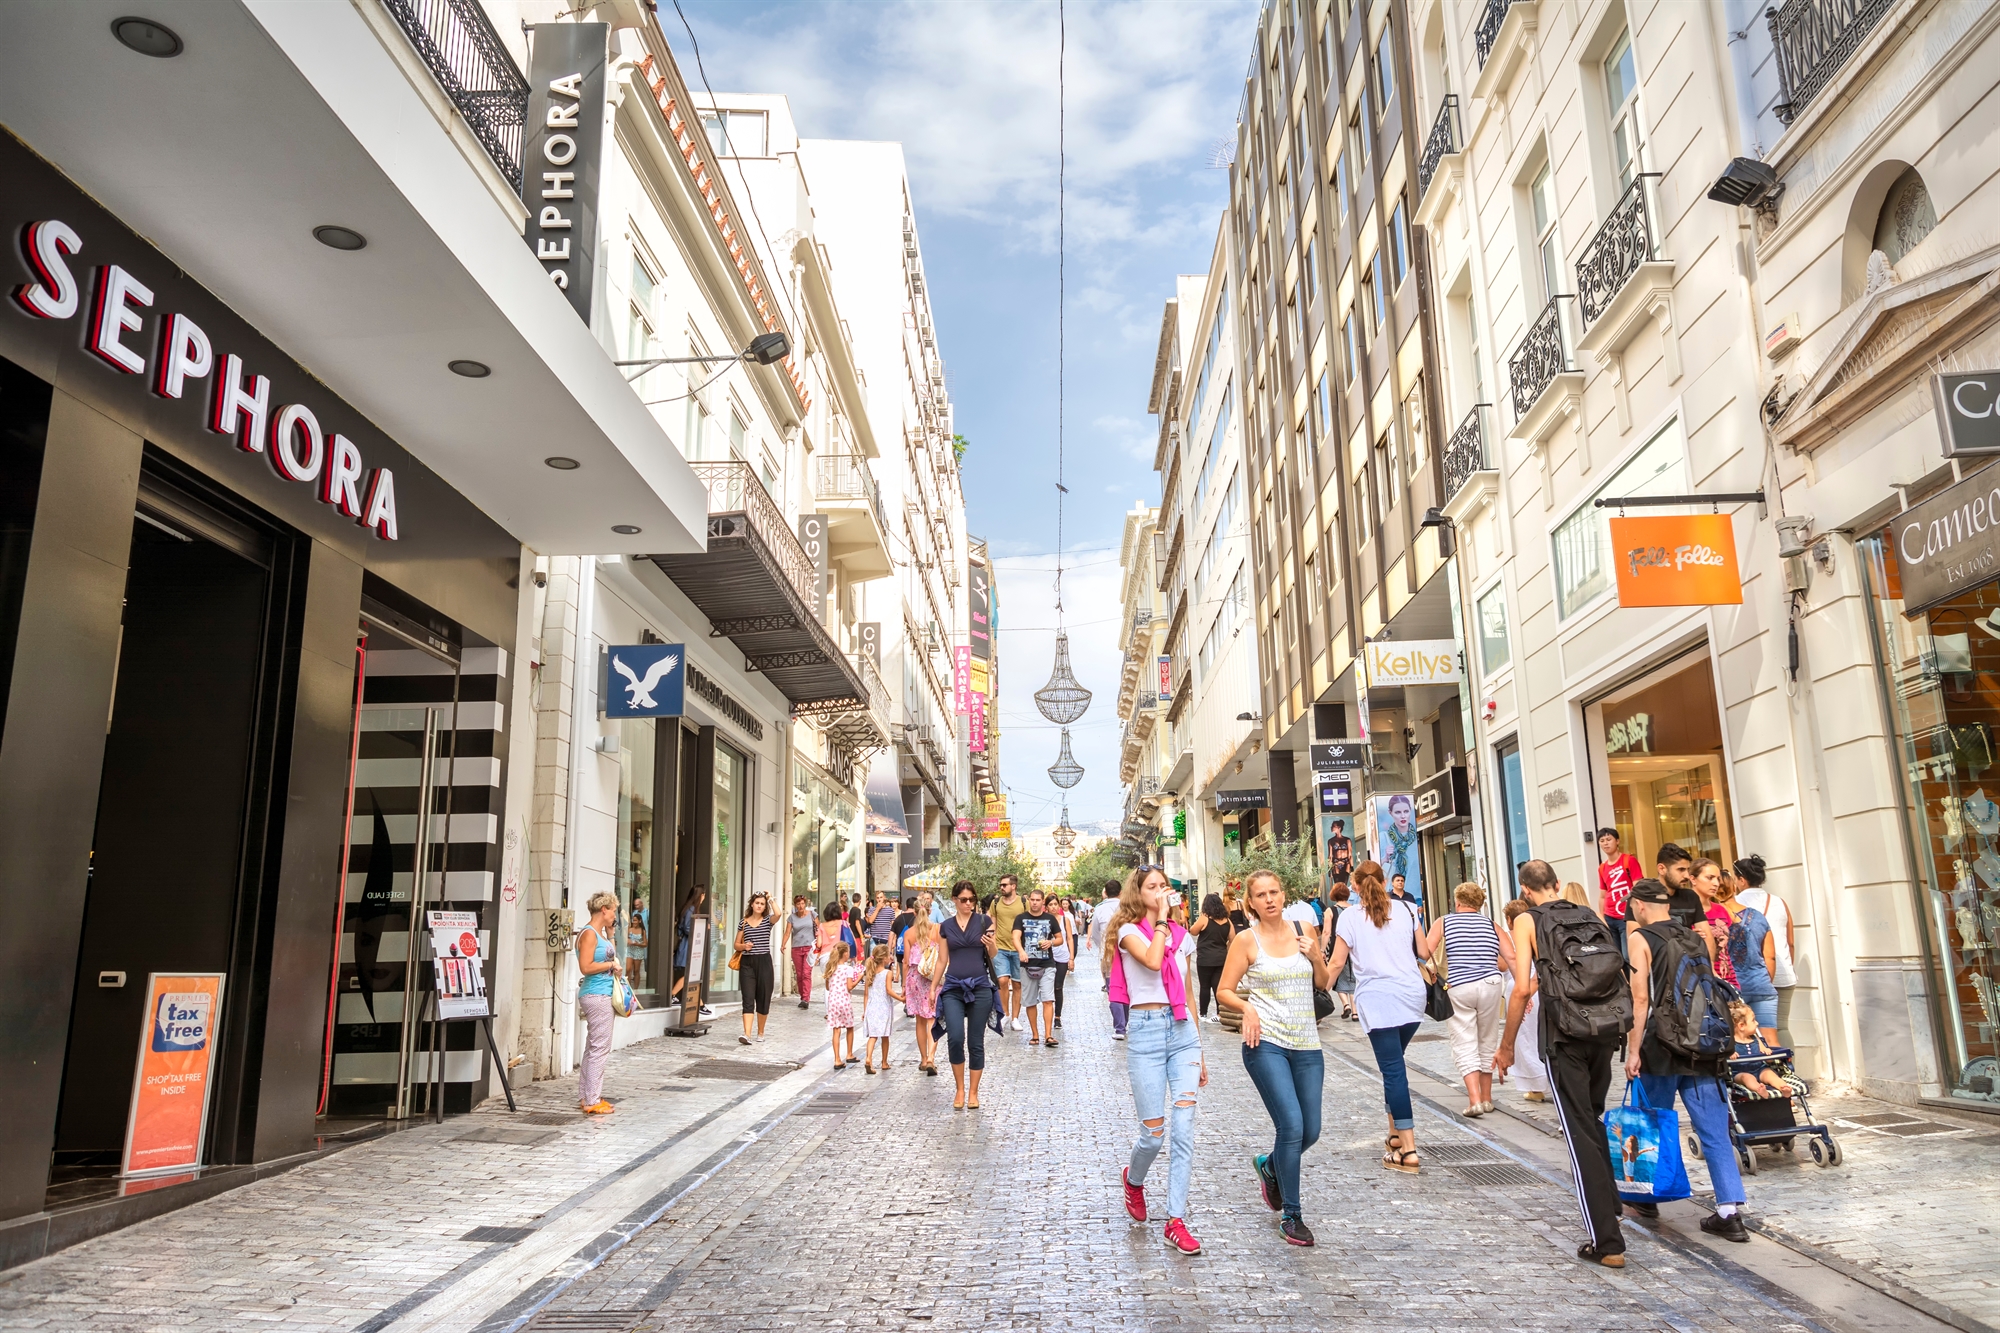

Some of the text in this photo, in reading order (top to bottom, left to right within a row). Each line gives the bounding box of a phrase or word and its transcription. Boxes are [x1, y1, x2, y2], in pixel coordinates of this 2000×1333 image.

[16, 219, 399, 541] SEPHORA
[1627, 544, 1725, 578] Folli Follie
[1946, 563, 1966, 585] Est
[1319, 773, 1350, 782] MED
[1217, 795, 1265, 803] ntimissimi
[460, 938, 476, 949] 20%
[168, 1003, 199, 1021] tax
[165, 1022, 203, 1040] free
[146, 1073, 202, 1085] SHOP TAX FREE
[160, 1086, 186, 1095] INSIDE
